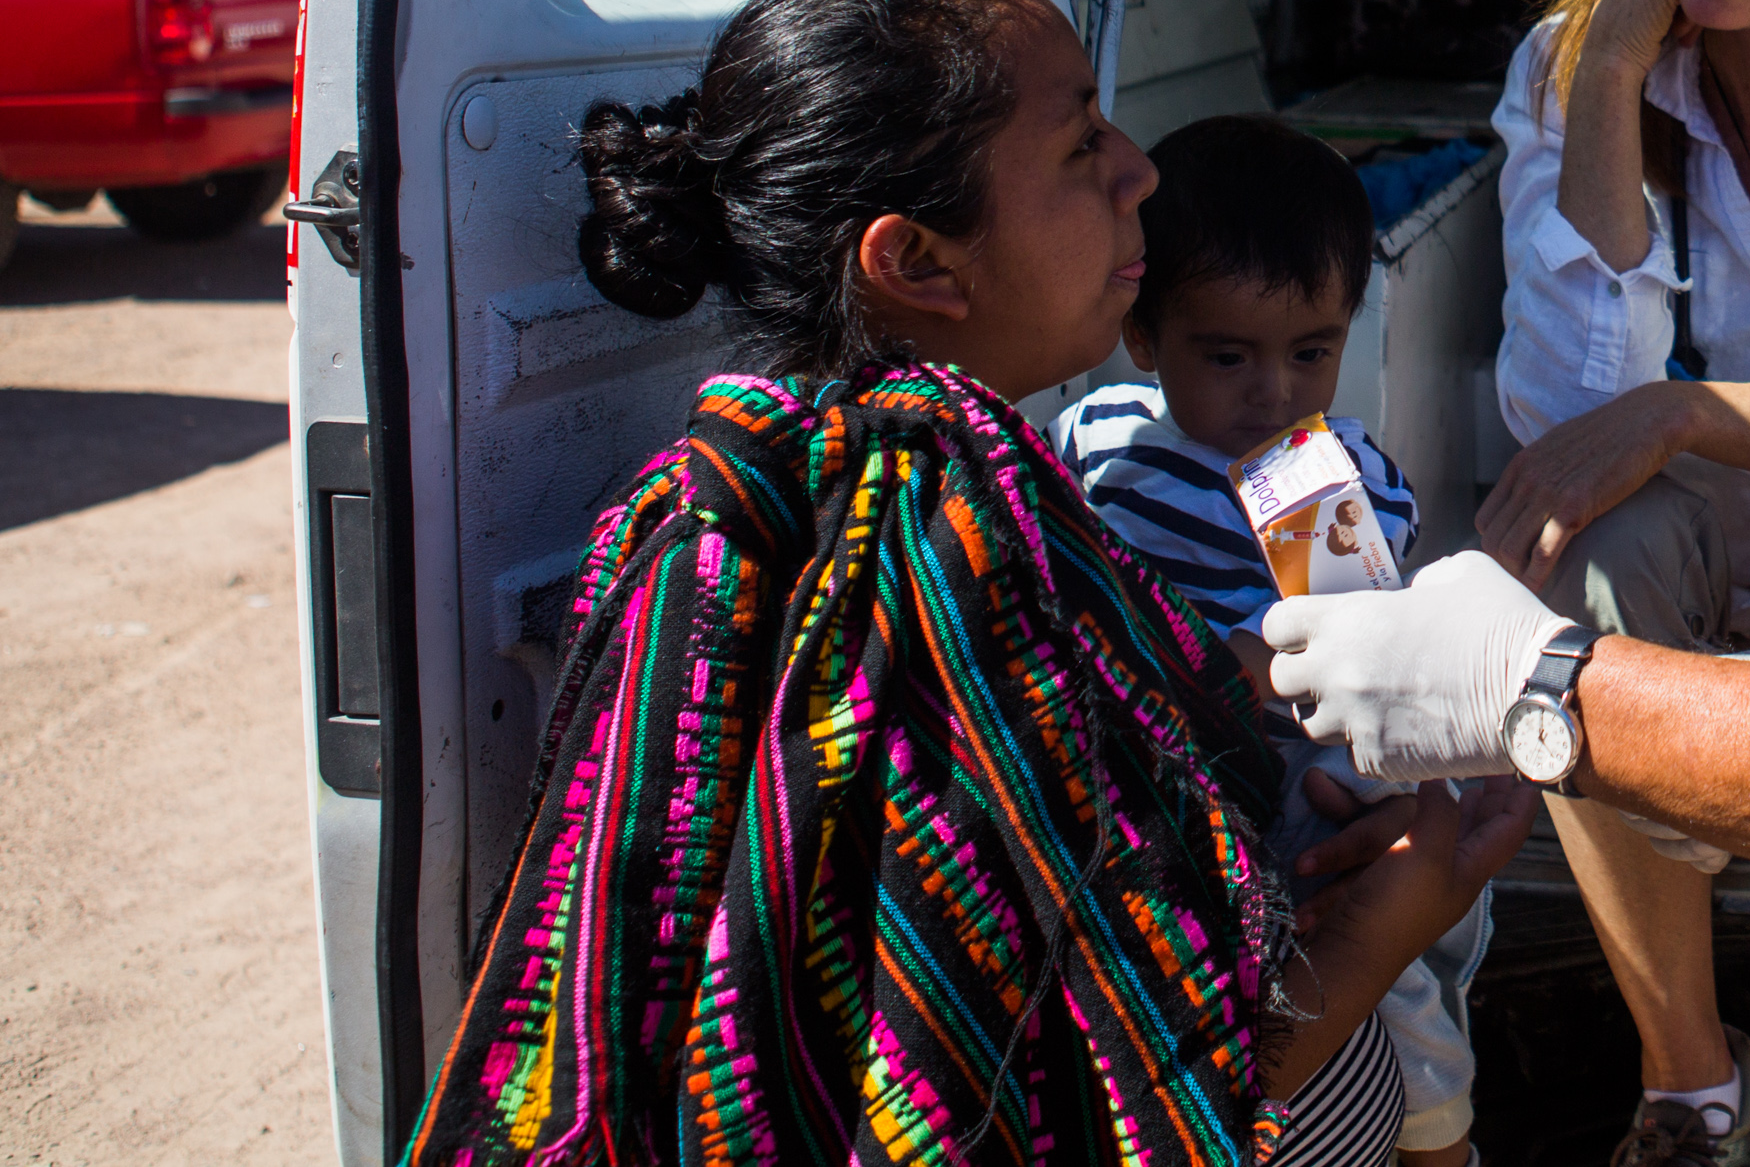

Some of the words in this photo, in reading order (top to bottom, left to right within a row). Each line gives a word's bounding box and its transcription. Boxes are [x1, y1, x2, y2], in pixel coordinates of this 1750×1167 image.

[1240, 457, 1281, 515] Dolprin
[1361, 555, 1376, 578] dolor
[1368, 541, 1386, 568] fiebre
